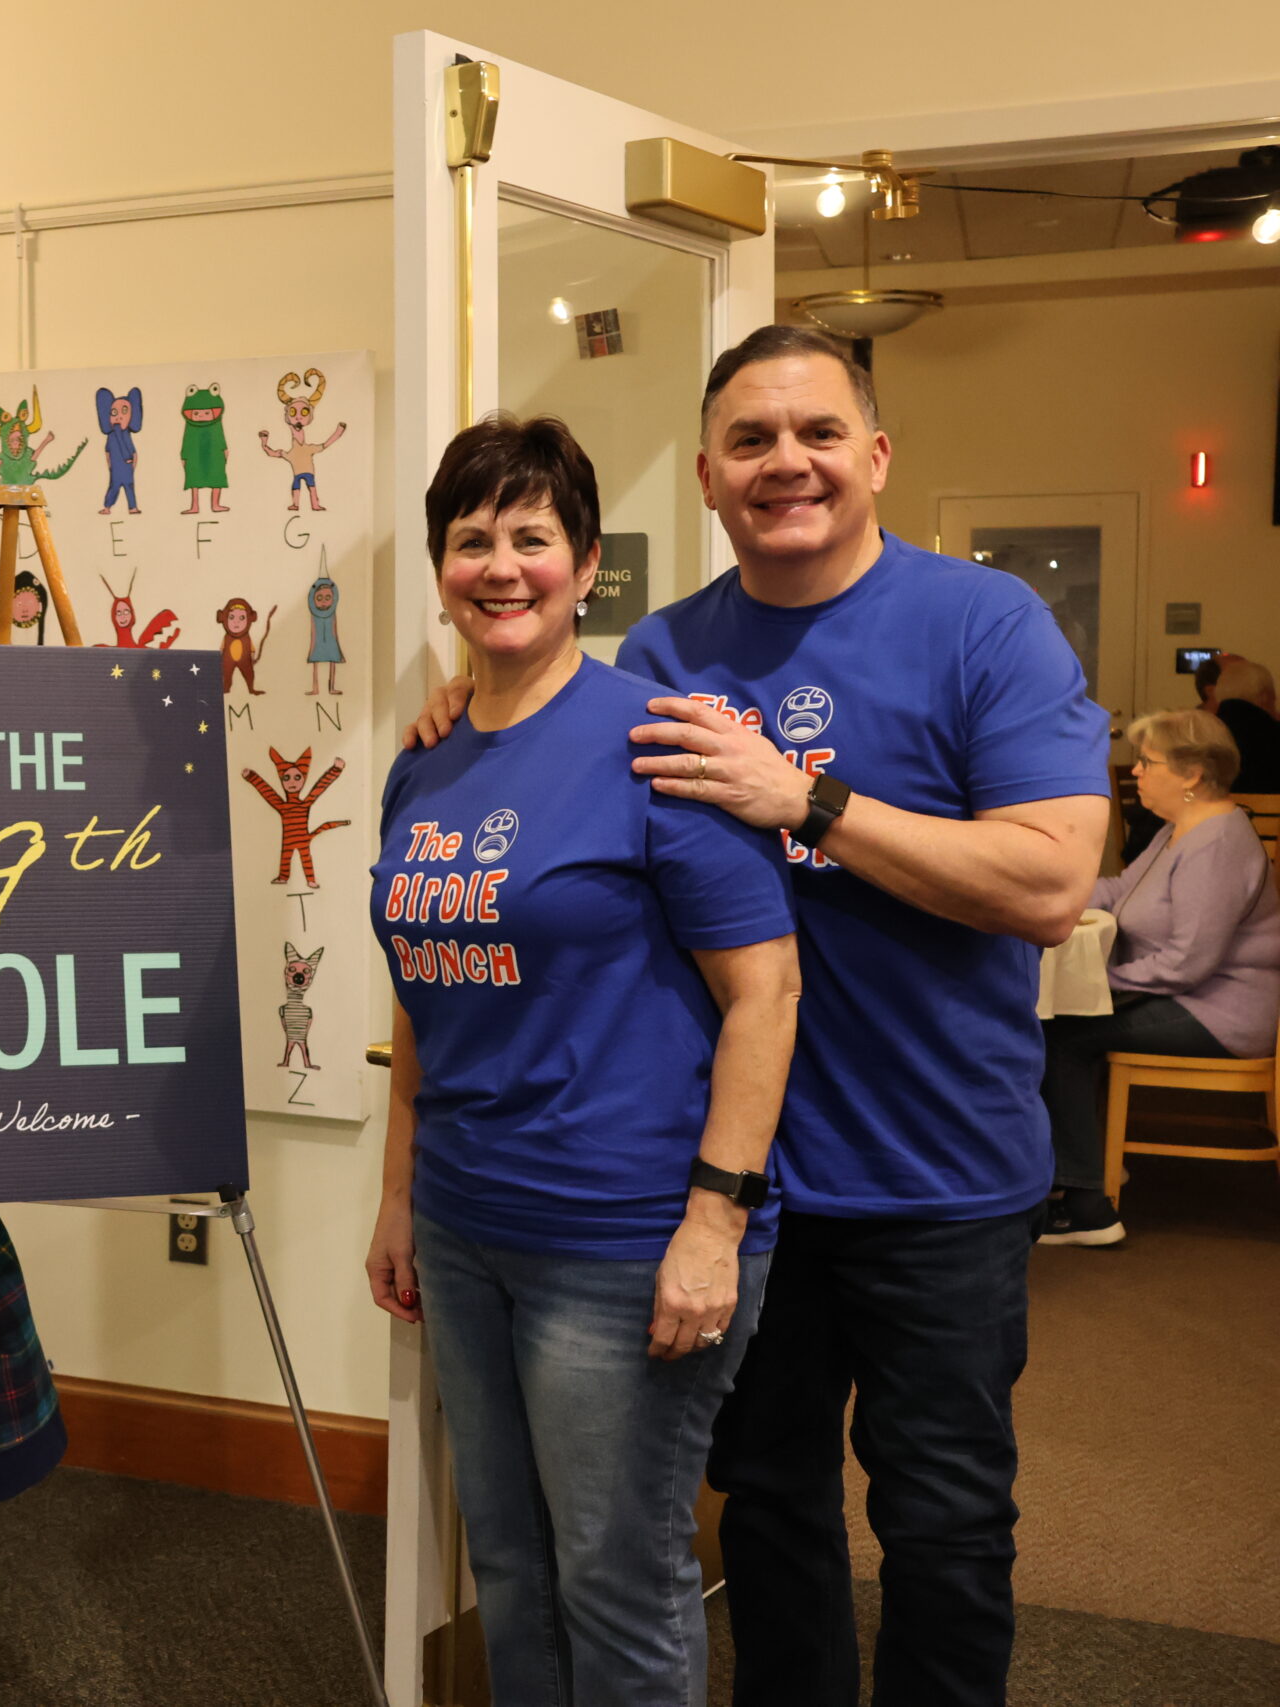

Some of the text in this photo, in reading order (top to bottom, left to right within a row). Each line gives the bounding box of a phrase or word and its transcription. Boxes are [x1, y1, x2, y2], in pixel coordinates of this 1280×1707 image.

[109, 521, 128, 557] E
[196, 521, 220, 560] F
[283, 515, 311, 549] G
[596, 569, 633, 582] TING
[228, 701, 342, 732] M N
[404, 821, 463, 862] The
[286, 892, 315, 932] T
[287, 1070, 316, 1107] Z
